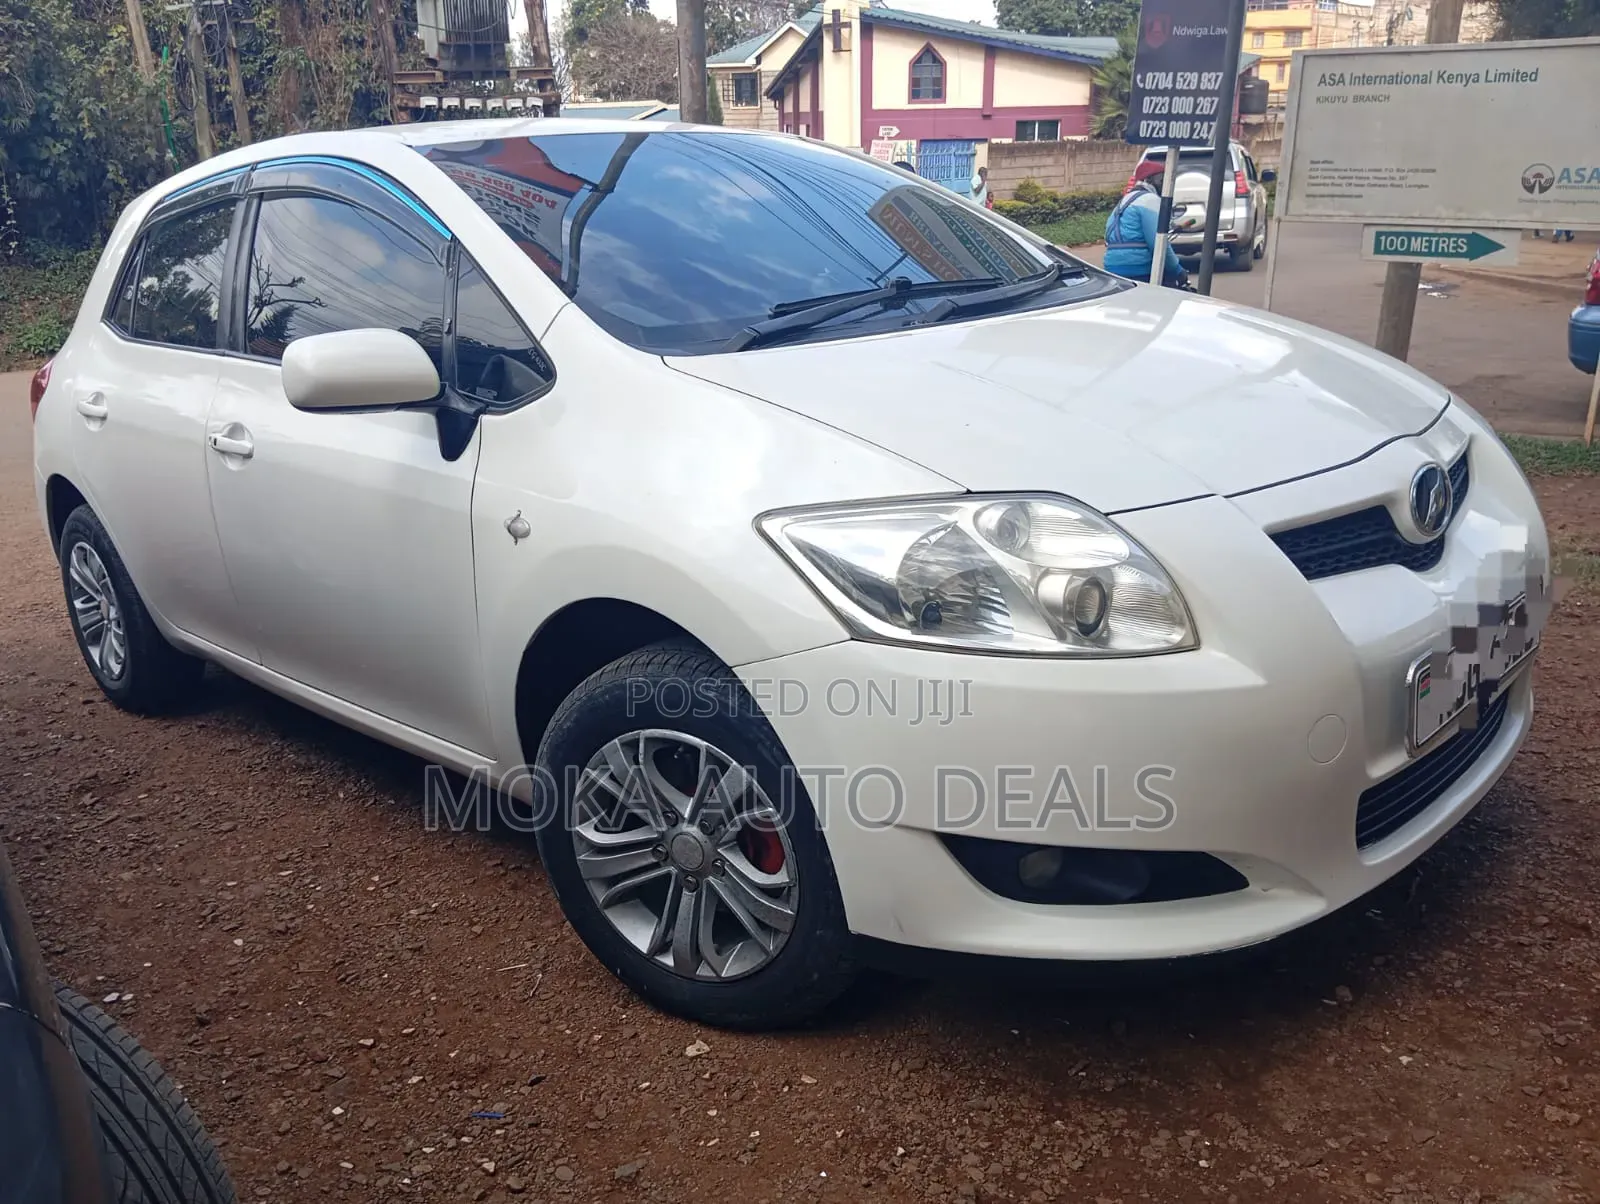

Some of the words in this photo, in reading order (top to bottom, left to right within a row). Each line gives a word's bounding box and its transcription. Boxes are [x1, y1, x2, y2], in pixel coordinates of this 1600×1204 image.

[1144, 71, 1174, 90] 0704
[1317, 72, 1346, 87] ASA
[1348, 70, 1433, 87] International
[1436, 69, 1480, 88] Kenya
[1484, 67, 1540, 84] Limited
[1142, 95, 1170, 114] 0723
[1171, 96, 1194, 115] 000
[1316, 95, 1348, 104] KIKUYU
[1352, 93, 1391, 103] BRANCH
[1139, 119, 1167, 138] 0723
[1168, 120, 1191, 139] 000
[1557, 167, 1600, 184] ASA
[1379, 235, 1408, 251] 100
[1409, 236, 1468, 253] METRES
